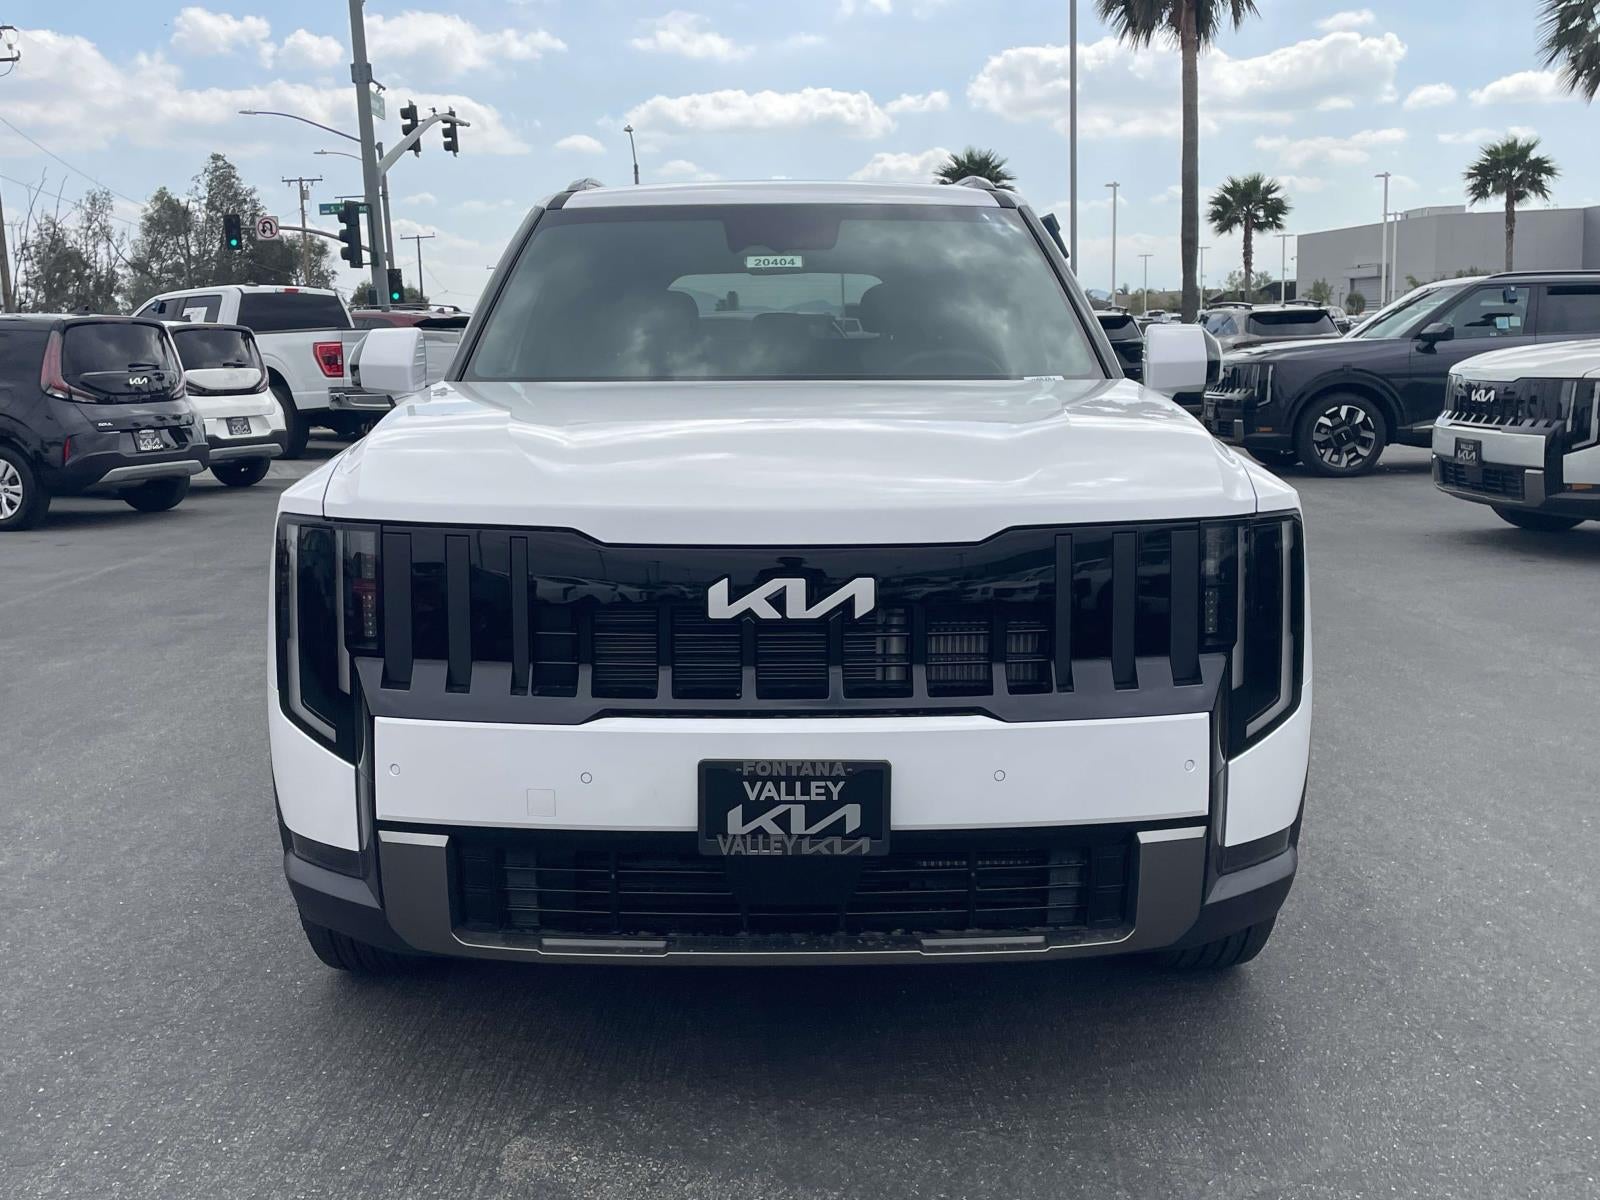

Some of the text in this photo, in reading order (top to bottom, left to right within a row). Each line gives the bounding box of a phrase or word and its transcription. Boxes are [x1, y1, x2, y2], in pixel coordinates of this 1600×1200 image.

[754, 258, 796, 267] 20404
[129, 377, 148, 385] KIA
[1471, 389, 1496, 402] KIA
[707, 577, 875, 619] KIA
[742, 761, 846, 777] FONTANA
[742, 781, 846, 801] VALLEY
[727, 803, 861, 835] KIA
[717, 834, 872, 856] VALLEY KIA
